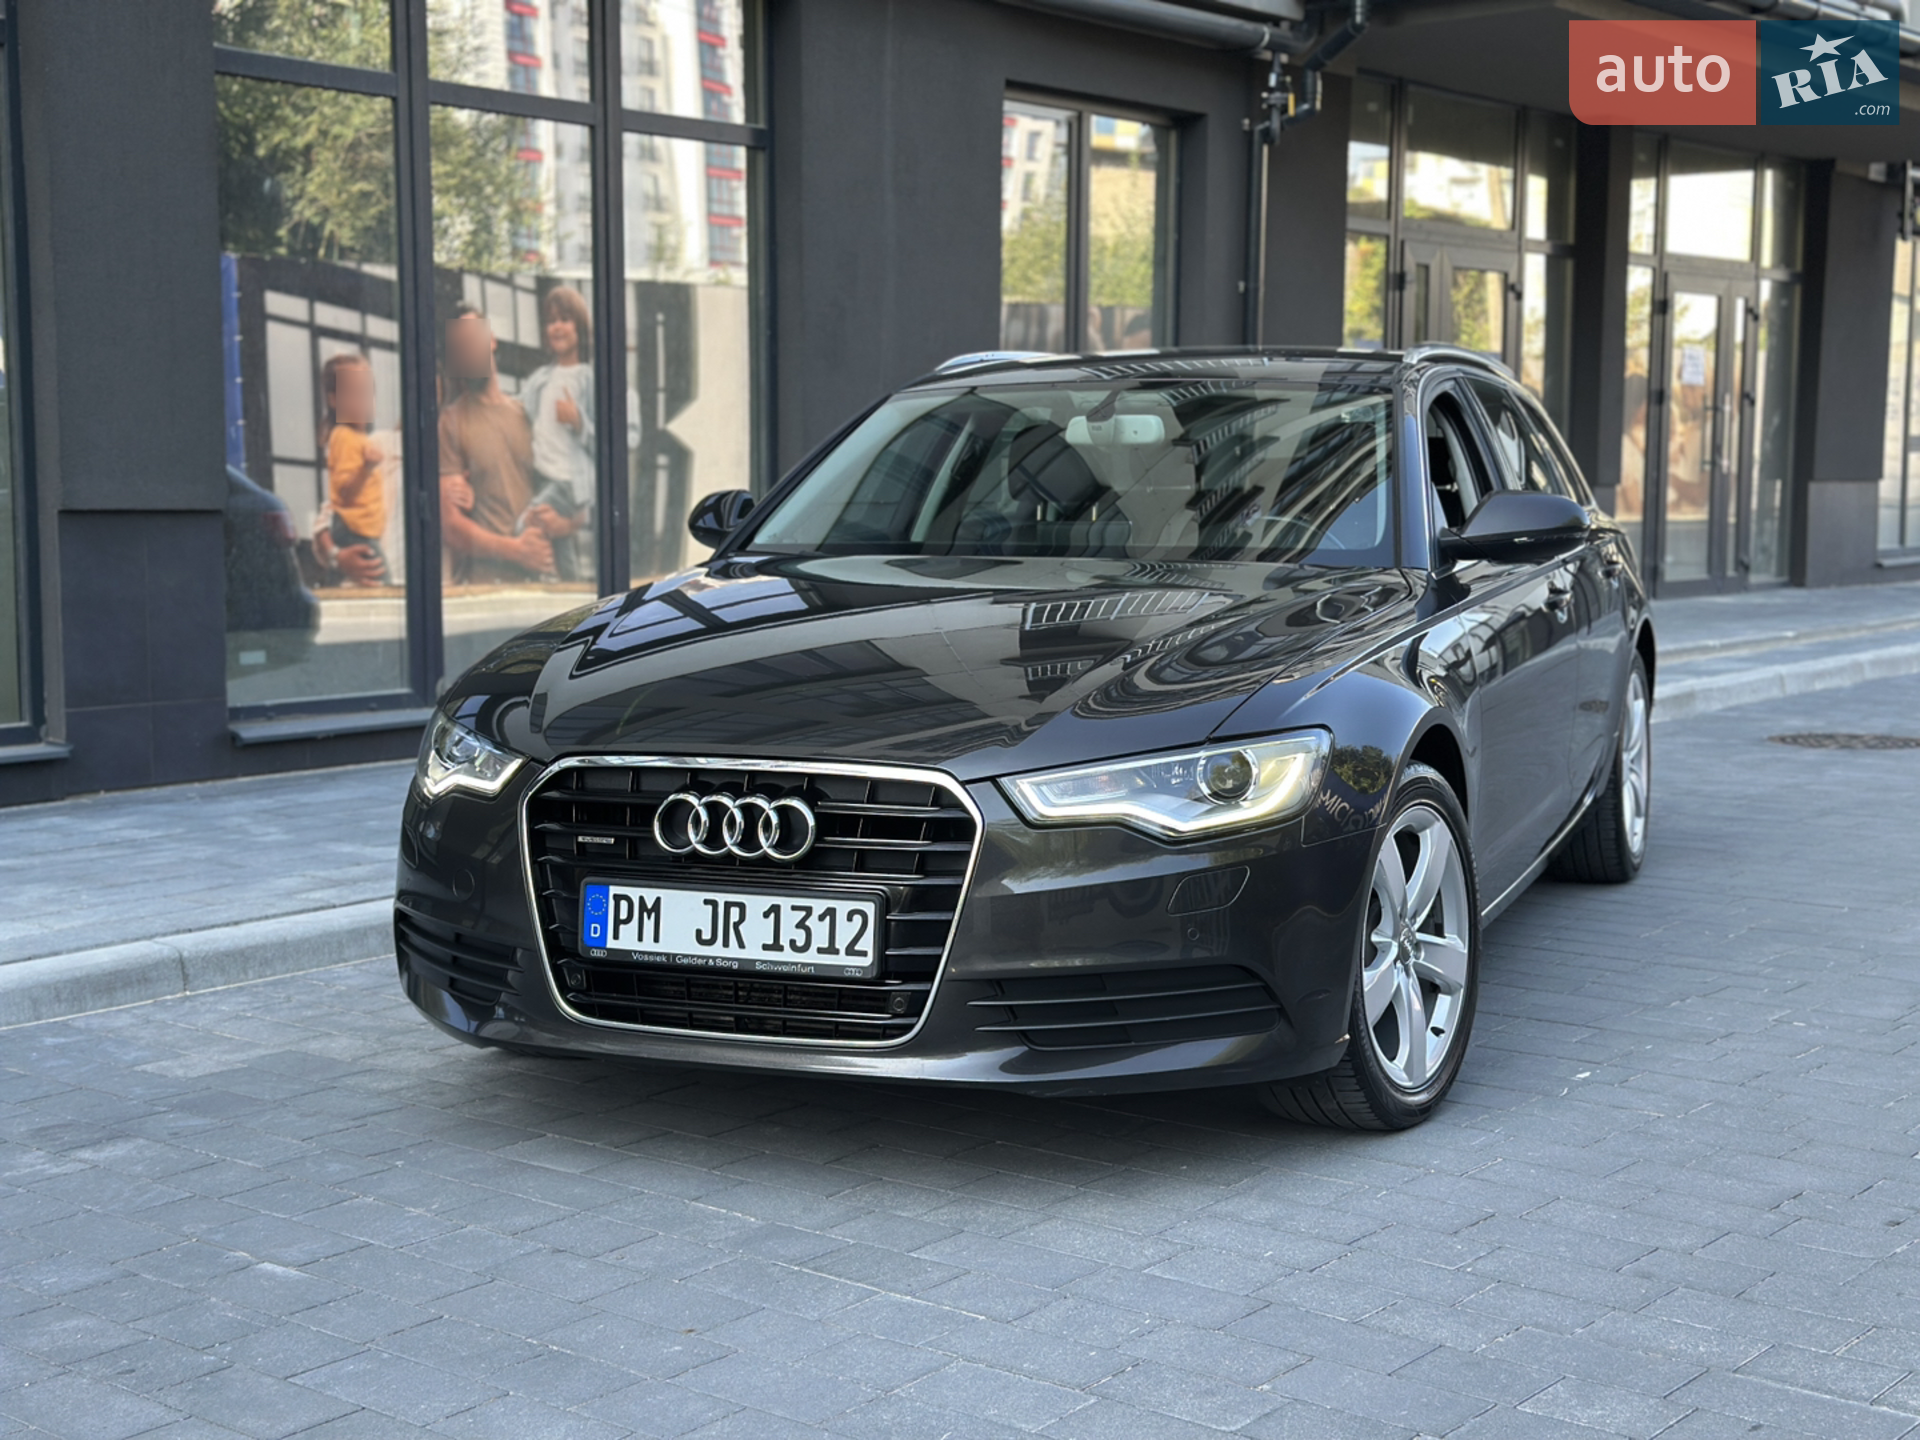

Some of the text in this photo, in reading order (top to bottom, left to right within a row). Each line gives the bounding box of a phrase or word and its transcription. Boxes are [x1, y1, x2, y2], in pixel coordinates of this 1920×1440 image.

[590, 923, 600, 938] D
[612, 893, 869, 957] PM JR 1312
[632, 952, 667, 962] Vossiek
[715, 959, 738, 969] Sorg
